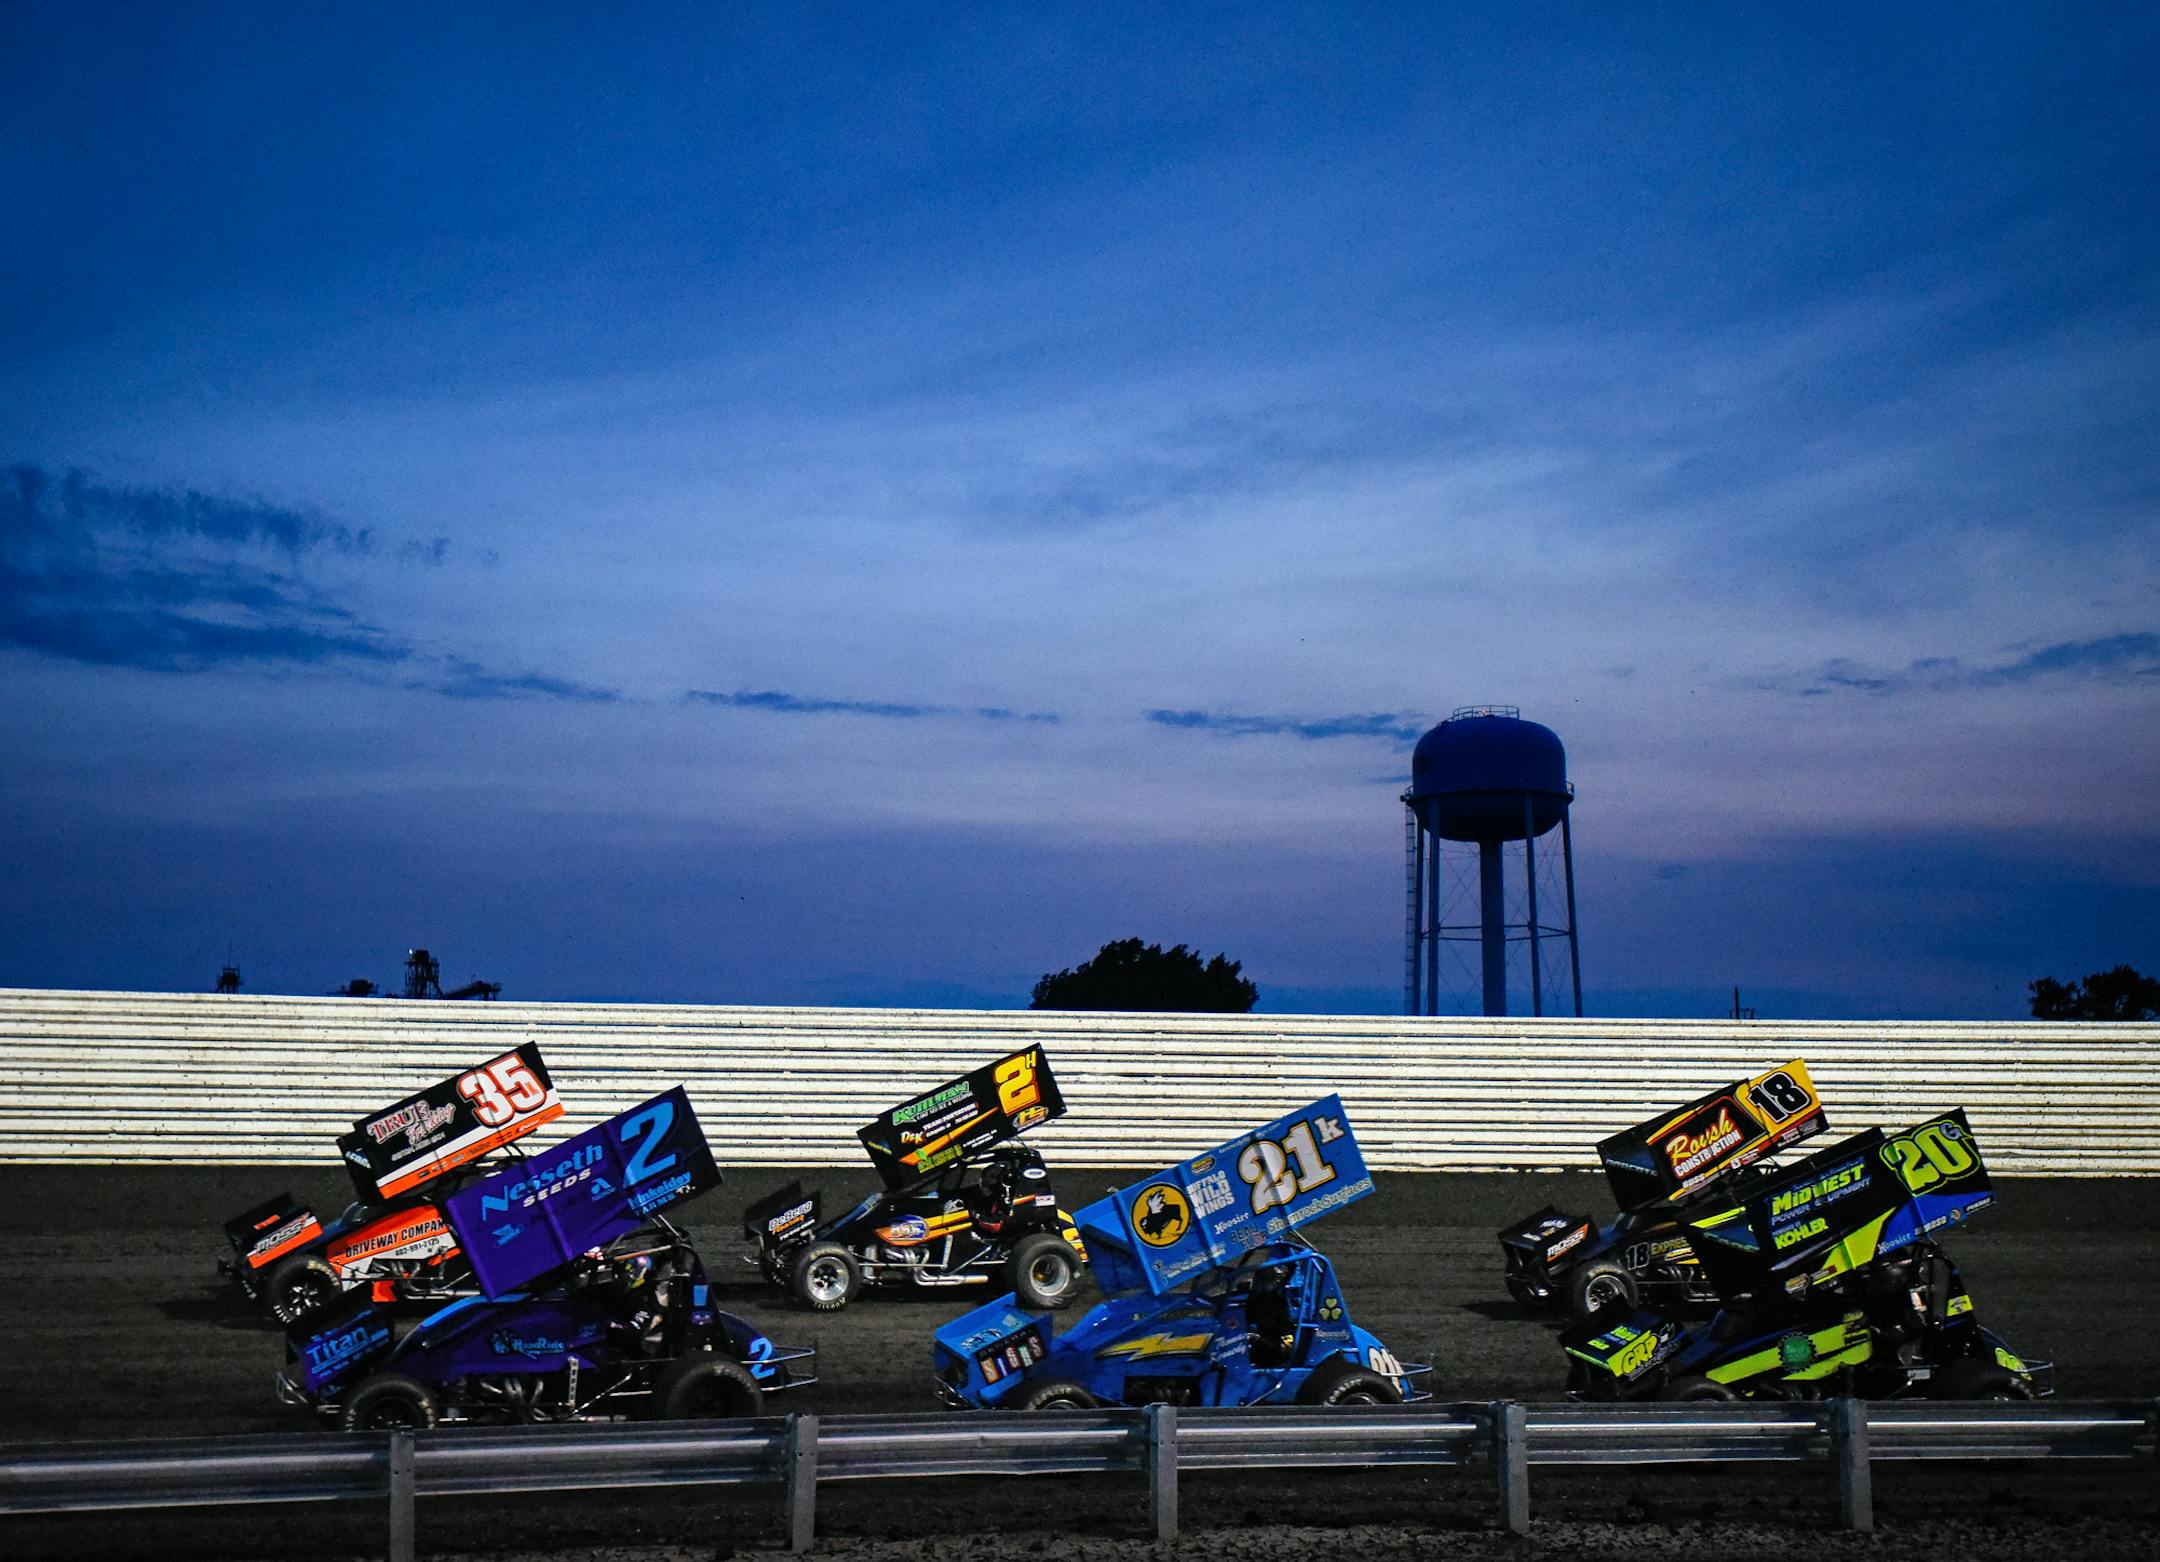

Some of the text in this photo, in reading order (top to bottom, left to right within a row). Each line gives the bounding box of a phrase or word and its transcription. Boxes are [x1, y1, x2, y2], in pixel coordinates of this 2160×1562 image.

[457, 1051, 547, 1127] 35
[1747, 1071, 1811, 1123] 18
[367, 1100, 430, 1144] TRUE
[1665, 1107, 1732, 1166] Roush
[620, 1101, 677, 1189] 2
[1674, 1130, 1742, 1177] CONSTRUCTION
[481, 1144, 603, 1221] Nesseth
[523, 1168, 591, 1208] SEEDS
[1189, 1179, 1231, 1207] WILD
[1772, 1163, 1864, 1215] MIDWEST
[1814, 1176, 1872, 1206] EUIPMENT
[1194, 1193, 1235, 1219] WINGS
[1214, 1212, 1249, 1235] Hoosier
[345, 1219, 446, 1258] DRIVEWAY COMPAN
[1775, 1218, 1829, 1249] KOHLER
[1625, 1241, 1650, 1271] 18
[748, 1337, 776, 1380] 2
[1622, 1335, 1658, 1374] GRP
